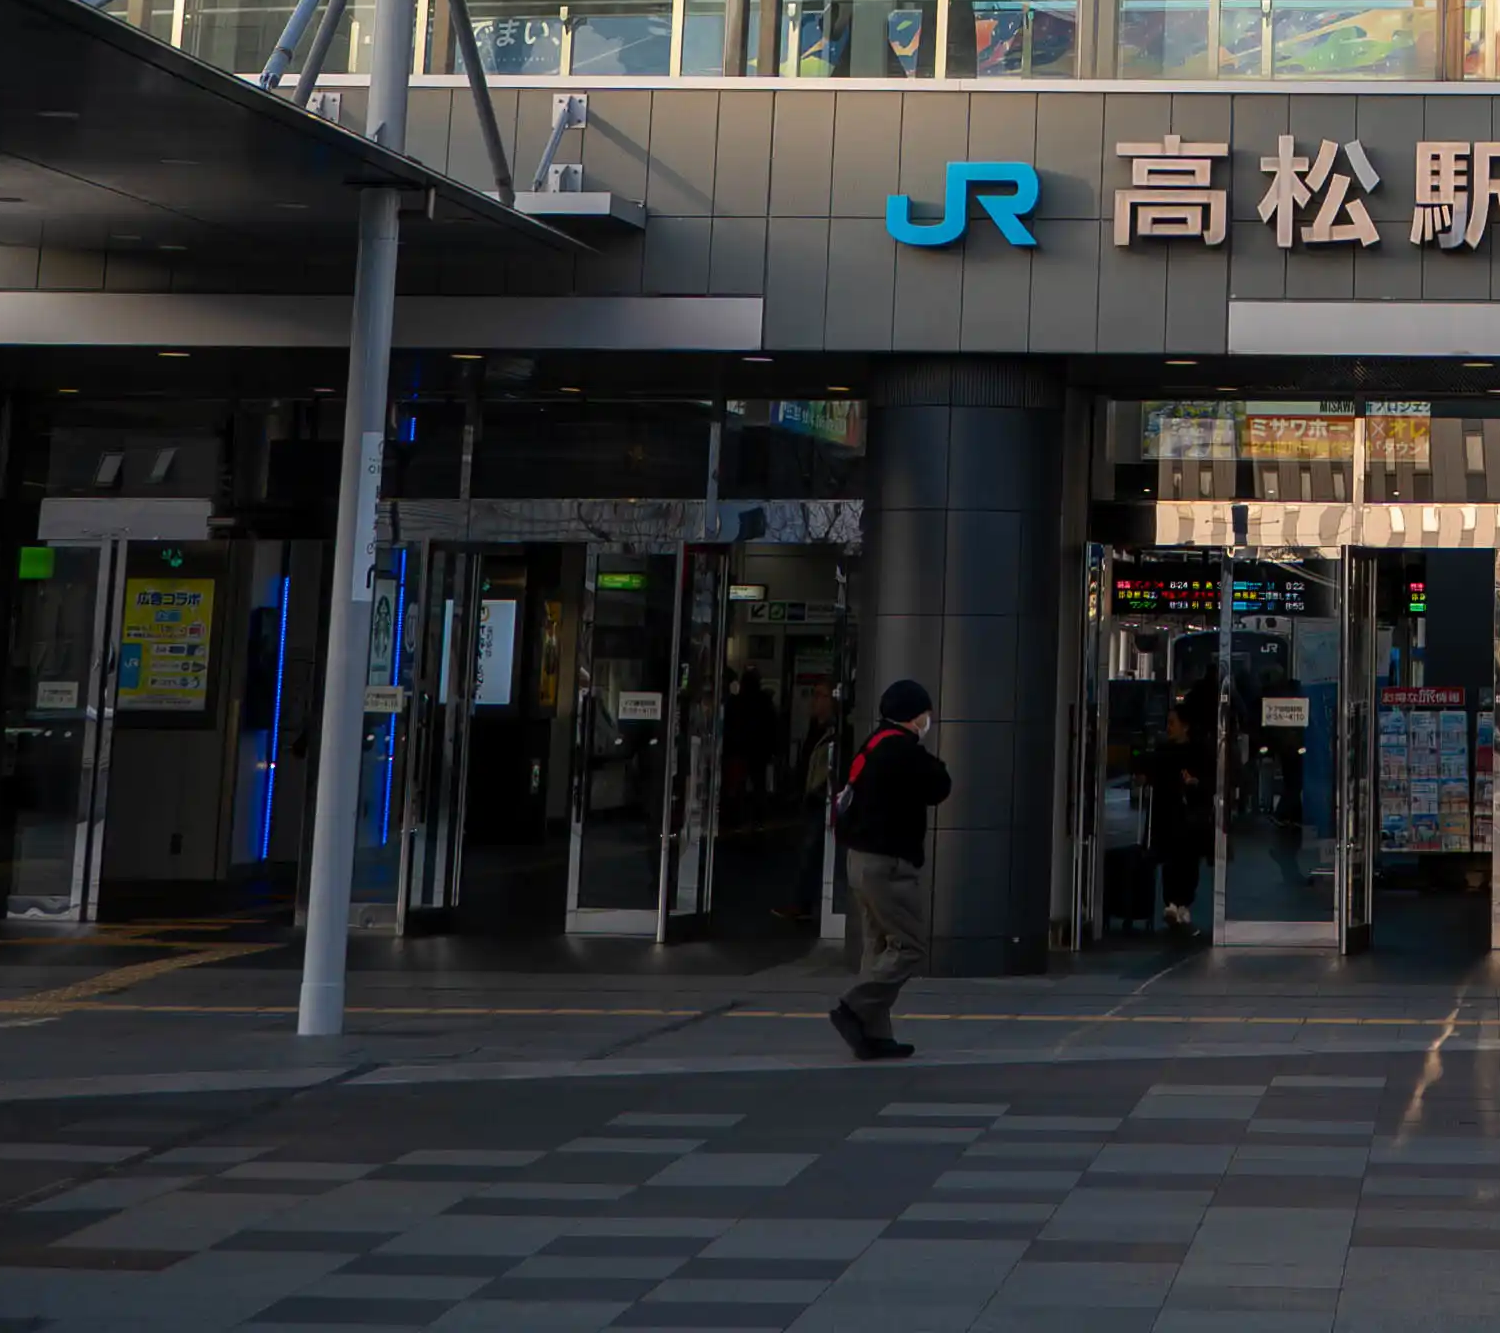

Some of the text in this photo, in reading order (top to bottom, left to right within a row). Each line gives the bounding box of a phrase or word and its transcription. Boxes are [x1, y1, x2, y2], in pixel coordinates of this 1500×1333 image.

[885, 159, 1042, 251] JR
[1260, 642, 1279, 654] JR
[1382, 688, 1460, 704] お得な旅情報
